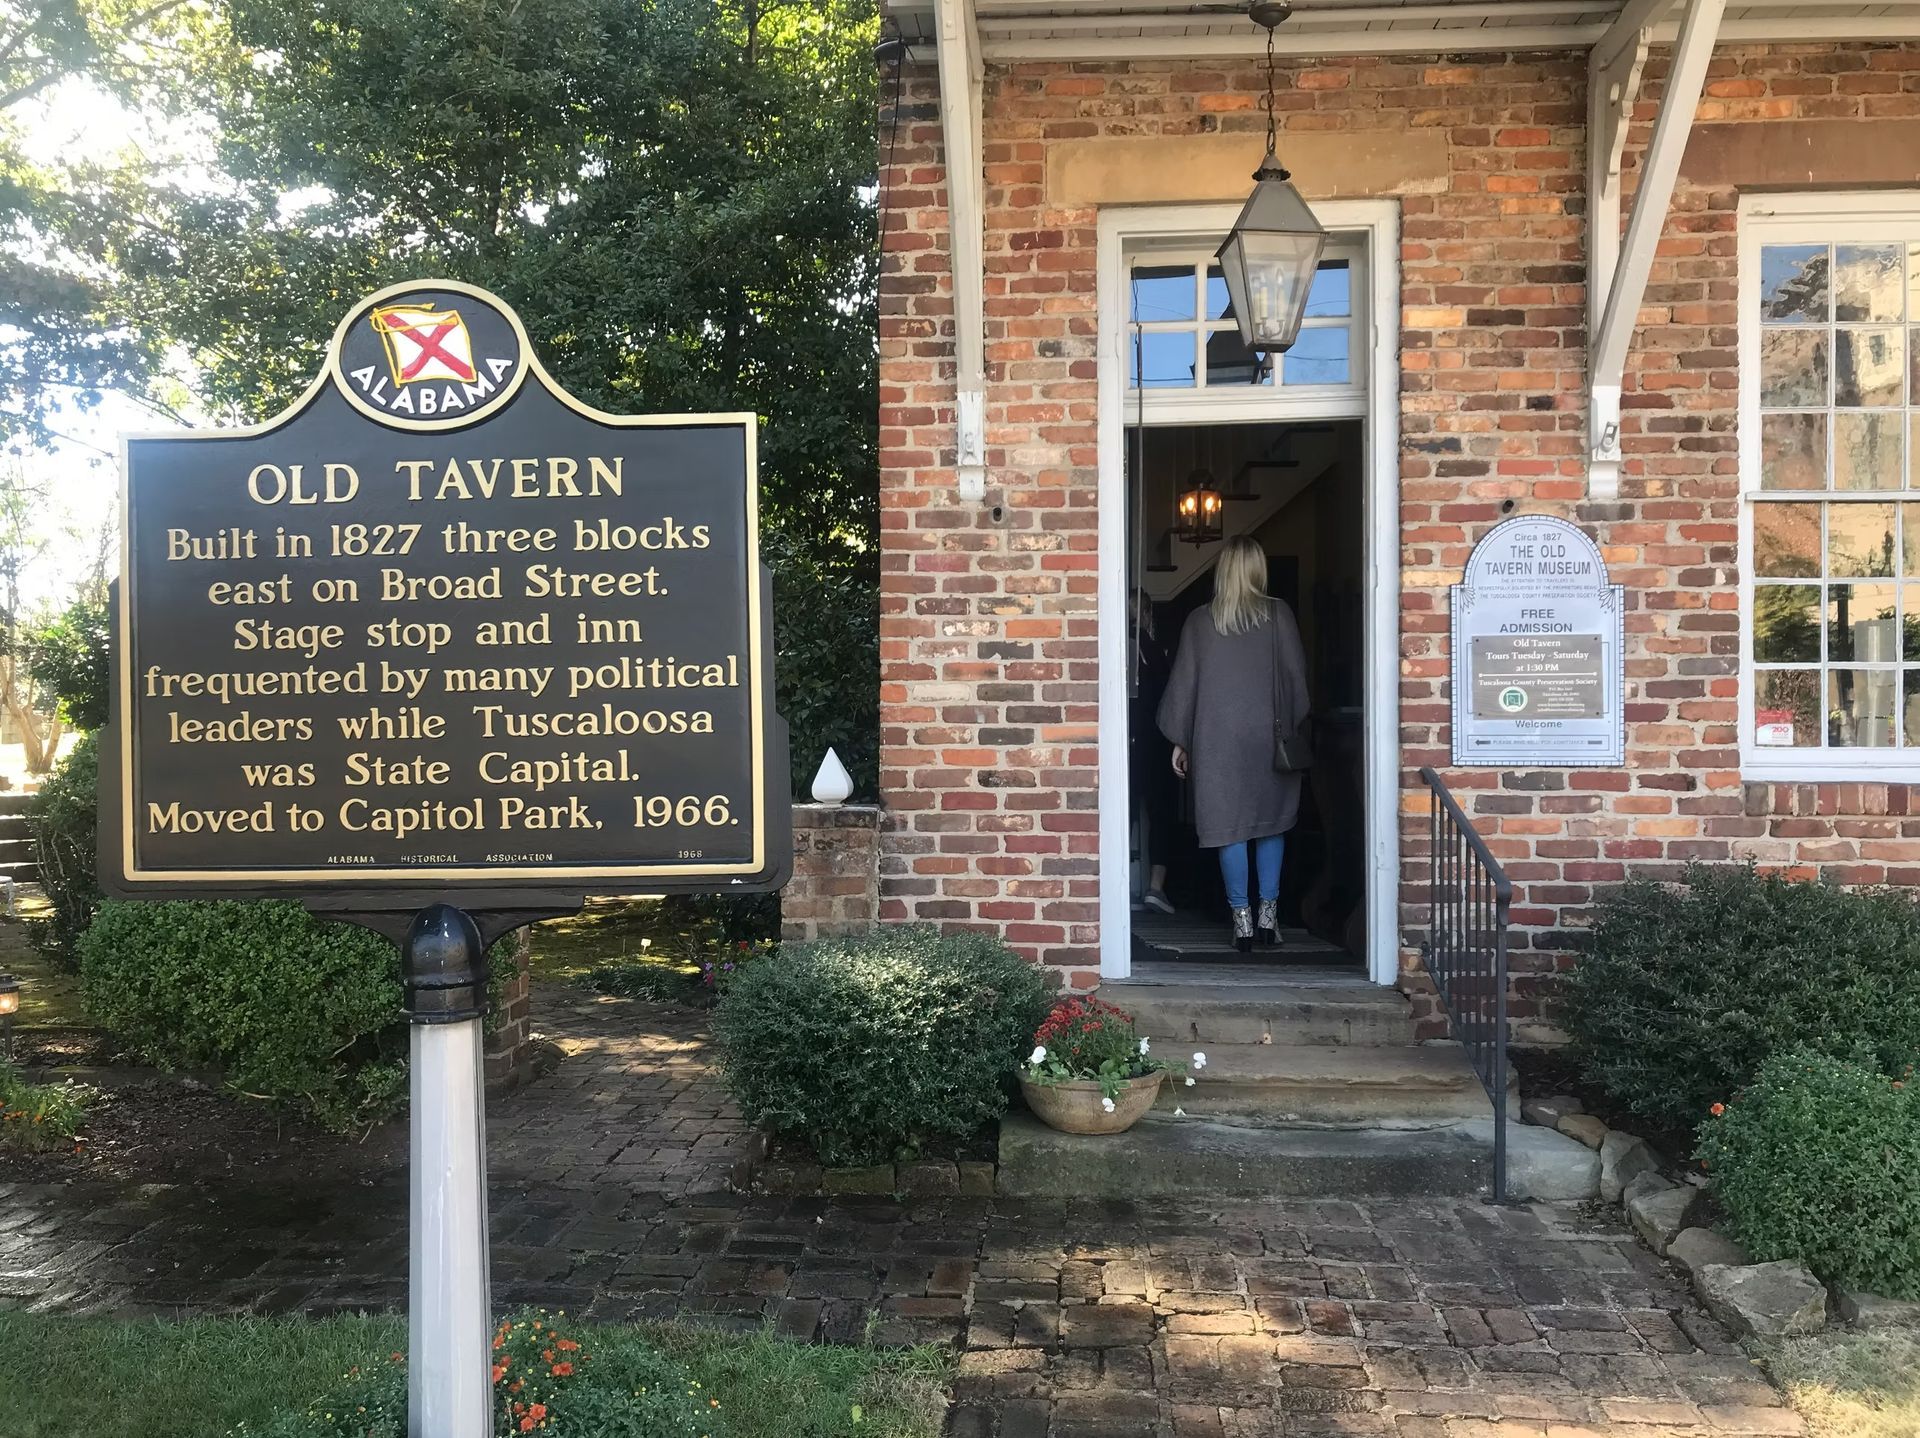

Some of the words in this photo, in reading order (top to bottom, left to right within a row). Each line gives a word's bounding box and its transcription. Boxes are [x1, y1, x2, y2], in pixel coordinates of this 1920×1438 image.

[350, 358, 513, 414] ALABAMA
[248, 464, 359, 504] OLD
[395, 457, 623, 500] TAVERN
[167, 528, 257, 560] Built
[276, 527, 312, 557] in
[331, 524, 422, 555] 1827
[442, 522, 556, 553] three
[574, 517, 709, 550] blocks
[1514, 533, 1537, 542] Circa
[1542, 533, 1562, 541] 1827
[1510, 545, 1534, 559] THE
[1540, 545, 1566, 558] OLD
[1485, 562, 1532, 575] TAVERN
[1538, 561, 1591, 575] MUSEUM
[209, 574, 292, 604] east
[313, 580, 358, 602] on
[381, 567, 502, 600] Broad
[526, 565, 667, 597] Street.
[1521, 609, 1555, 619] FREE
[1500, 623, 1573, 633] ADMISSION
[235, 619, 344, 658] Stage
[367, 618, 451, 653] stop
[476, 613, 551, 644] and
[578, 613, 642, 643] inn
[1513, 639, 1529, 648] Old
[1531, 639, 1561, 647] Tavern
[1485, 652, 1510, 660] Tours
[1511, 651, 1546, 661] Tuesday
[1553, 650, 1589, 660] Saturday
[1515, 664, 1524, 672] at
[144, 662, 367, 703] frequented
[381, 661, 430, 699] by
[444, 667, 554, 697] many
[569, 655, 739, 697] political
[1512, 679, 1536, 687] County
[169, 711, 312, 742] leaders
[337, 707, 445, 739] while
[473, 704, 713, 737] Tuscaloosa
[1515, 720, 1563, 728] Welcome
[242, 764, 315, 786] was
[345, 753, 450, 785] State
[479, 750, 639, 791] Capital.
[148, 802, 274, 833] Moved
[286, 804, 324, 831] to
[340, 798, 484, 838] Capitol
[500, 797, 602, 829] Park,
[633, 795, 738, 827] 1966.
[326, 855, 376, 864] ALABAMA
[400, 855, 459, 864] HISTORICAL
[485, 853, 553, 863] ASSOCIATION
[677, 850, 703, 859] 1968
